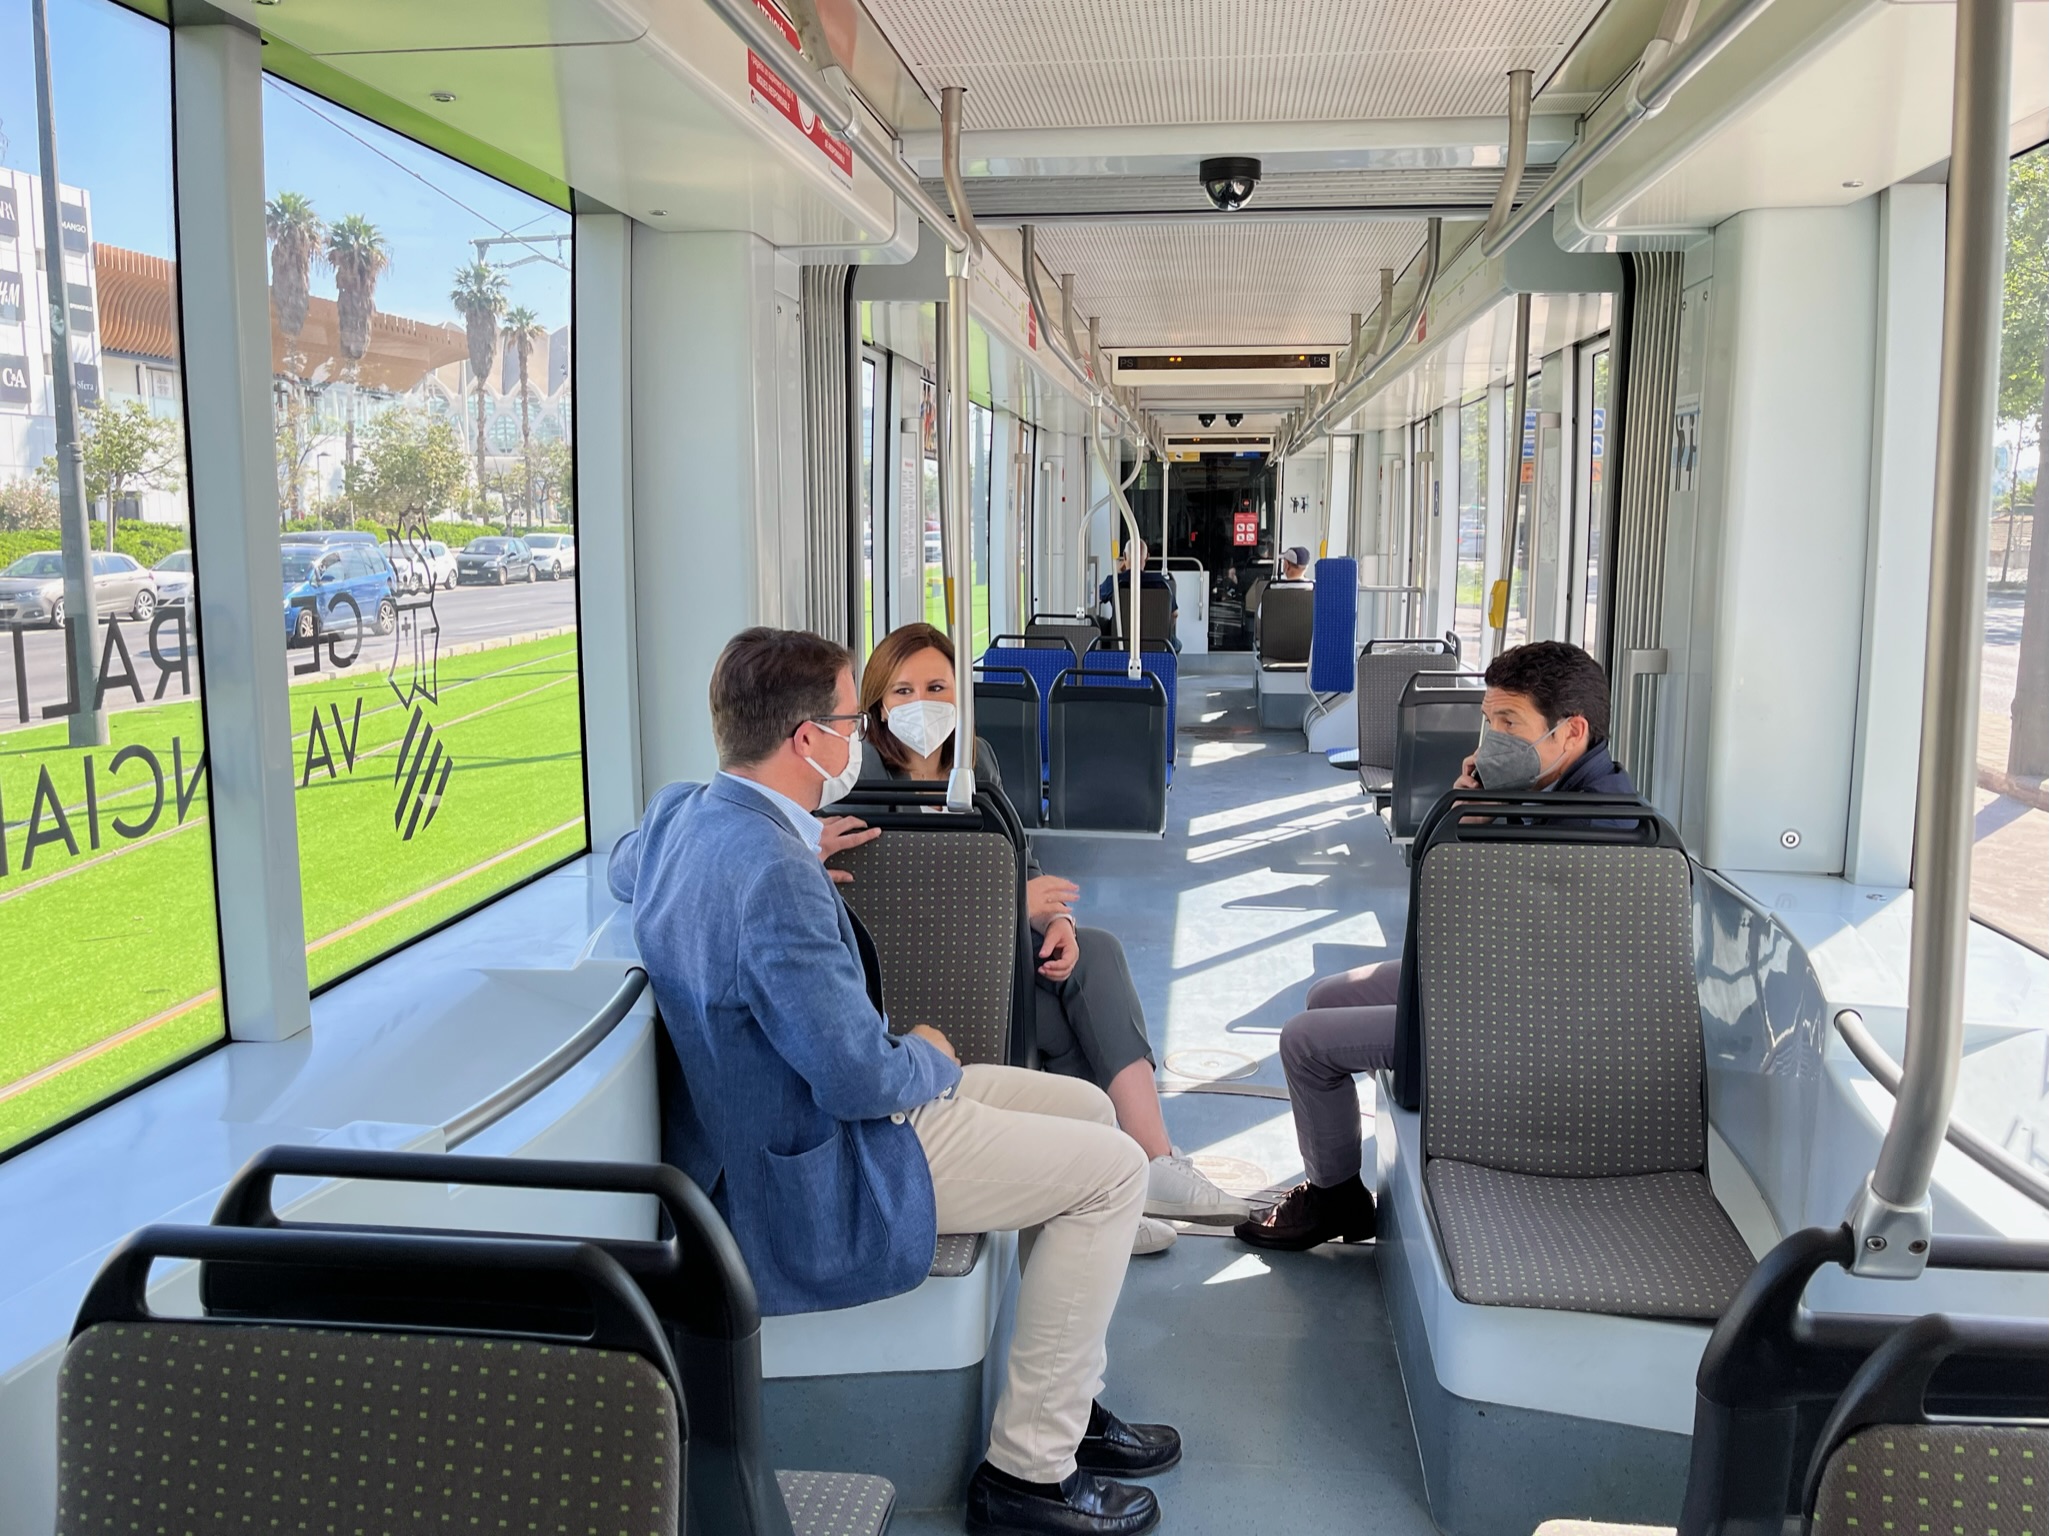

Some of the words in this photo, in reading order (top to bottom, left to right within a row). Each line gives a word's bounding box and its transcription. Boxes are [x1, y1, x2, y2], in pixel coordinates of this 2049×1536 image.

[61, 221, 86, 234] MANGO
[2, 367, 27, 389] C&A
[76, 380, 94, 391] Sfera
